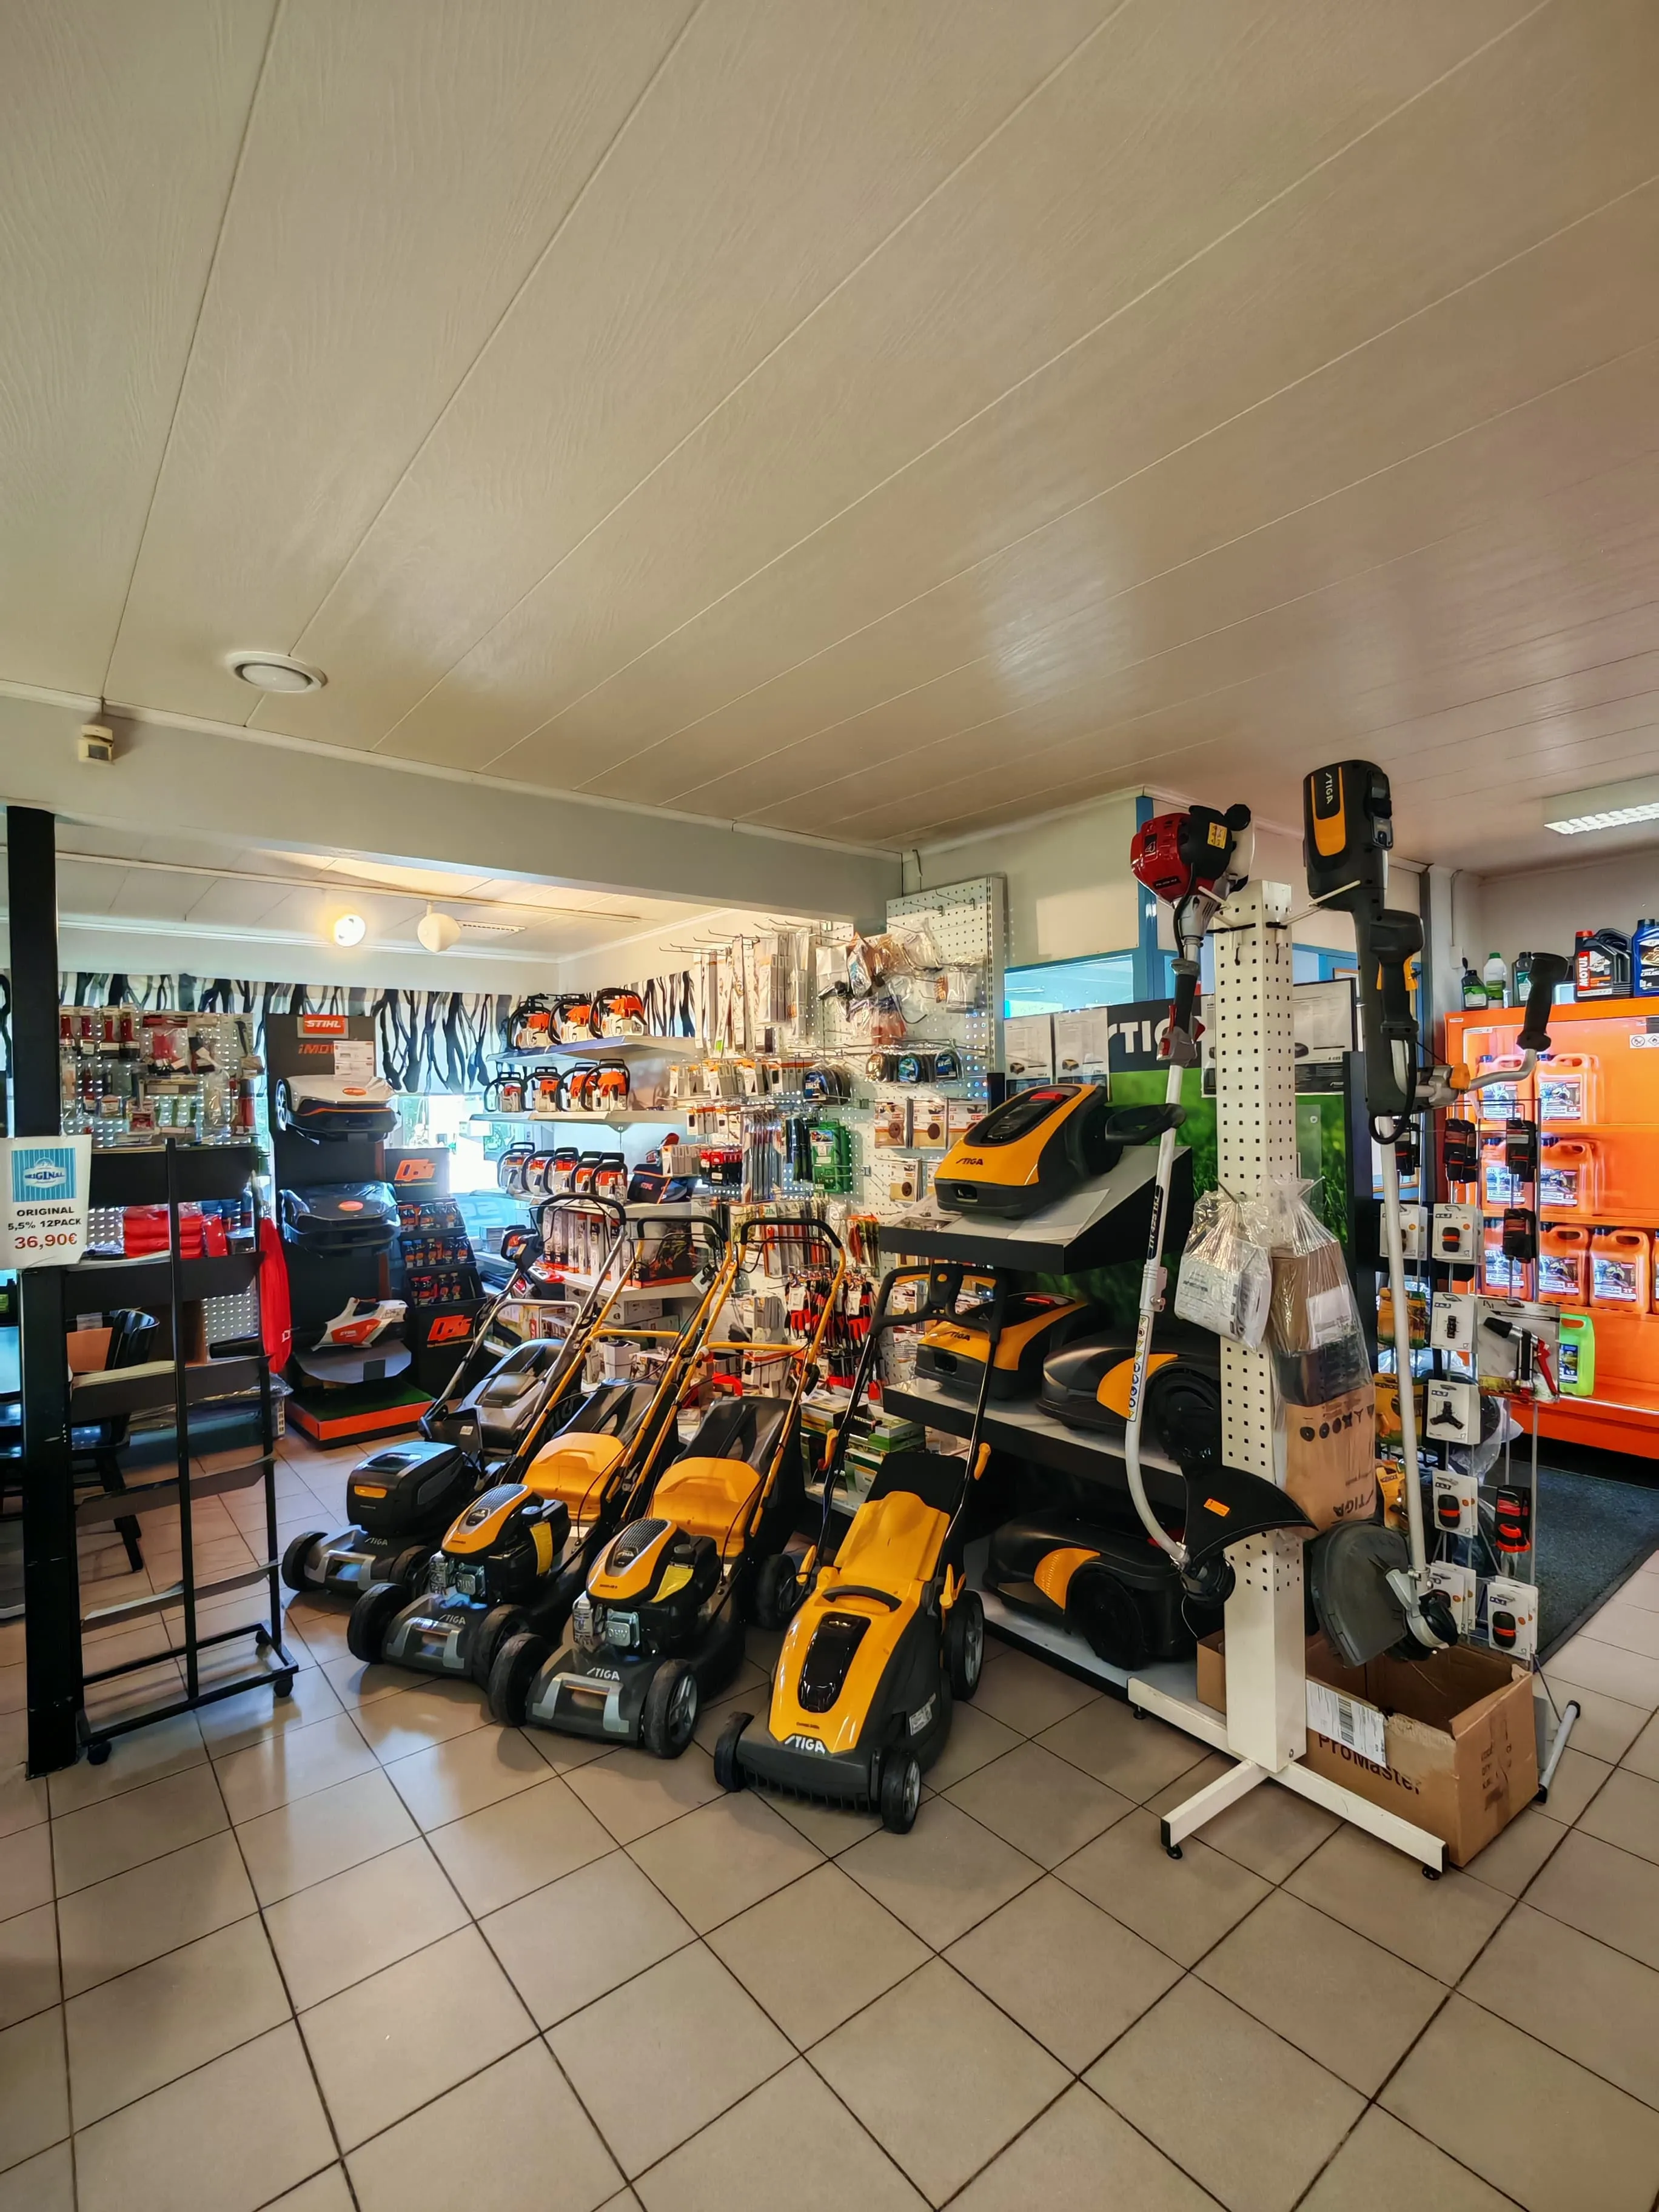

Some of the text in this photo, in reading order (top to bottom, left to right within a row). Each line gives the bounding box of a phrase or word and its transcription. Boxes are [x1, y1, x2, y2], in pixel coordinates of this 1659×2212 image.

[1325, 772, 1333, 805] STIGA
[1578, 956, 1589, 987] MOTUL
[304, 1019, 341, 1028] STIHL
[298, 1043, 335, 1054] iMO
[956, 1158, 984, 1166] STIGA
[16, 1207, 75, 1217] ORIGINAL
[8, 1218, 82, 1231] 5,5% 12PACK
[15, 1233, 78, 1250] 36,90€
[1333, 1489, 1374, 1517] STIGA
[364, 1537, 388, 1546] STIGA
[439, 1614, 466, 1625] STIGA
[587, 1667, 620, 1681] STIGA
[784, 1735, 825, 1754] STIGA
[1318, 1734, 1420, 1795] ProMaste
